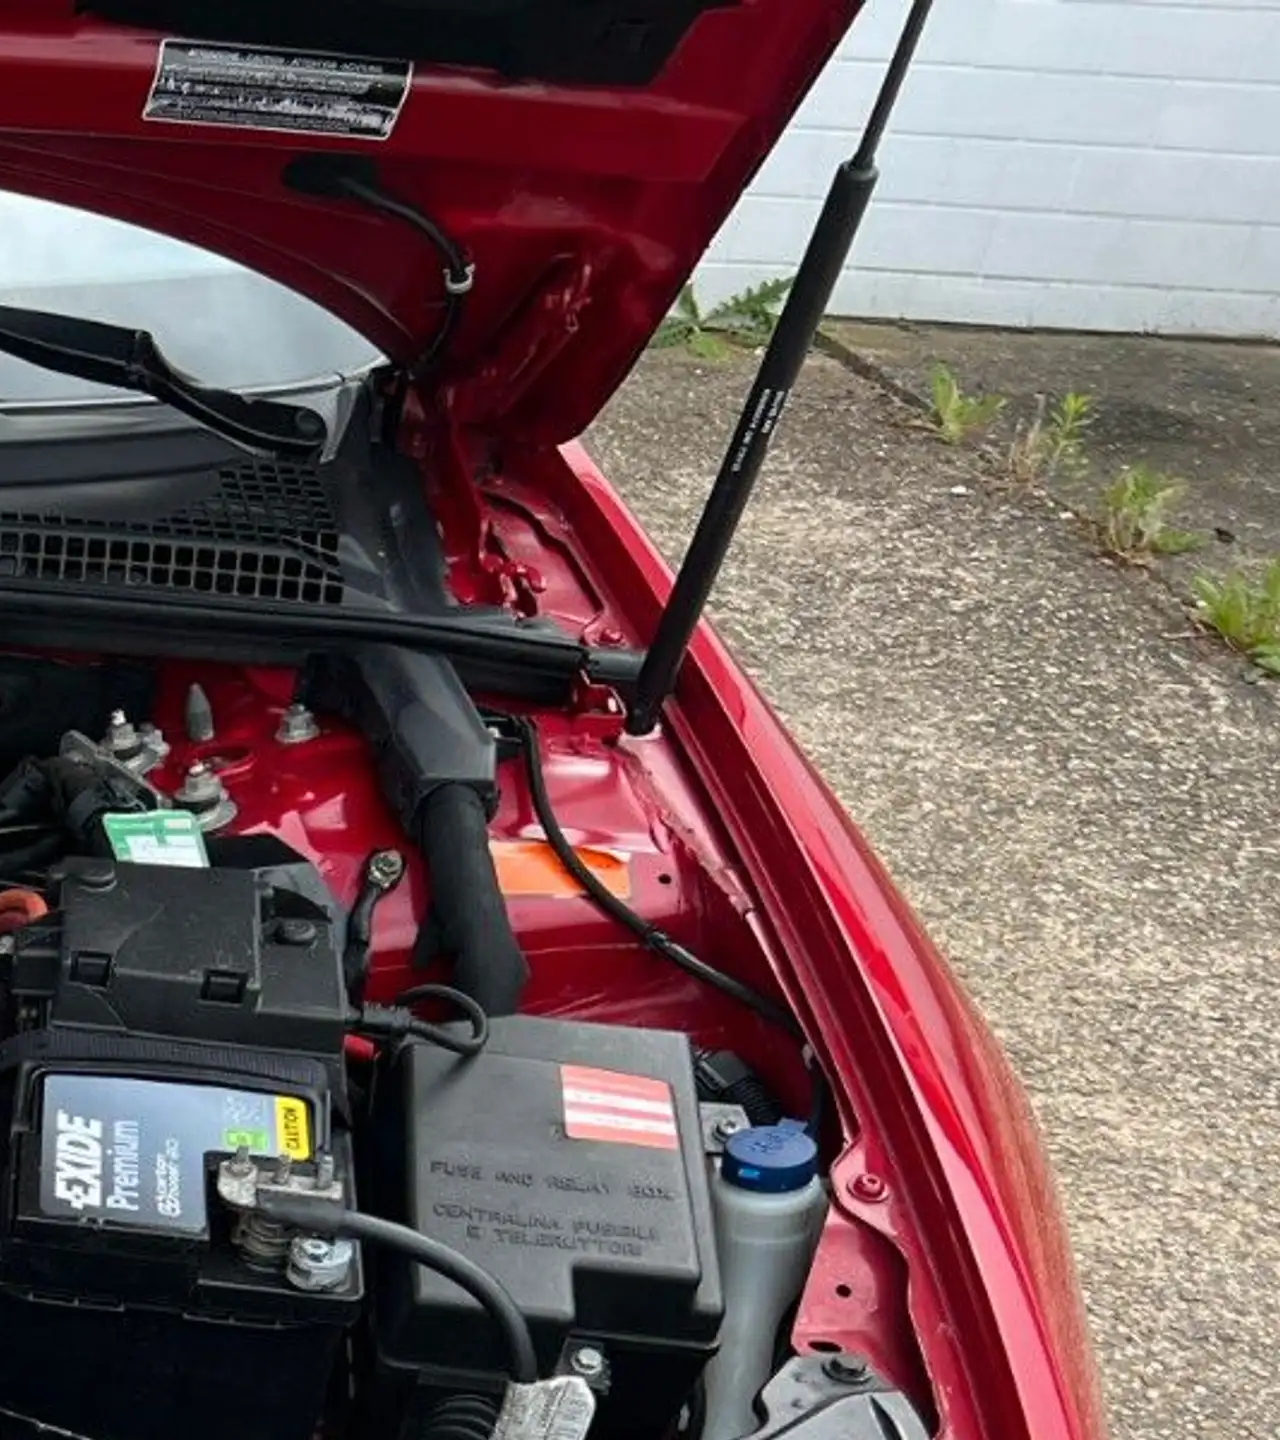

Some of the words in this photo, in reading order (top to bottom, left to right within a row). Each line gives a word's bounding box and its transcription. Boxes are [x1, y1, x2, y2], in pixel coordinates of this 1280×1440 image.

[55, 1108, 102, 1209] EXIDE
[106, 1120, 140, 1211] Premium
[430, 1160, 482, 1181] FUSE
